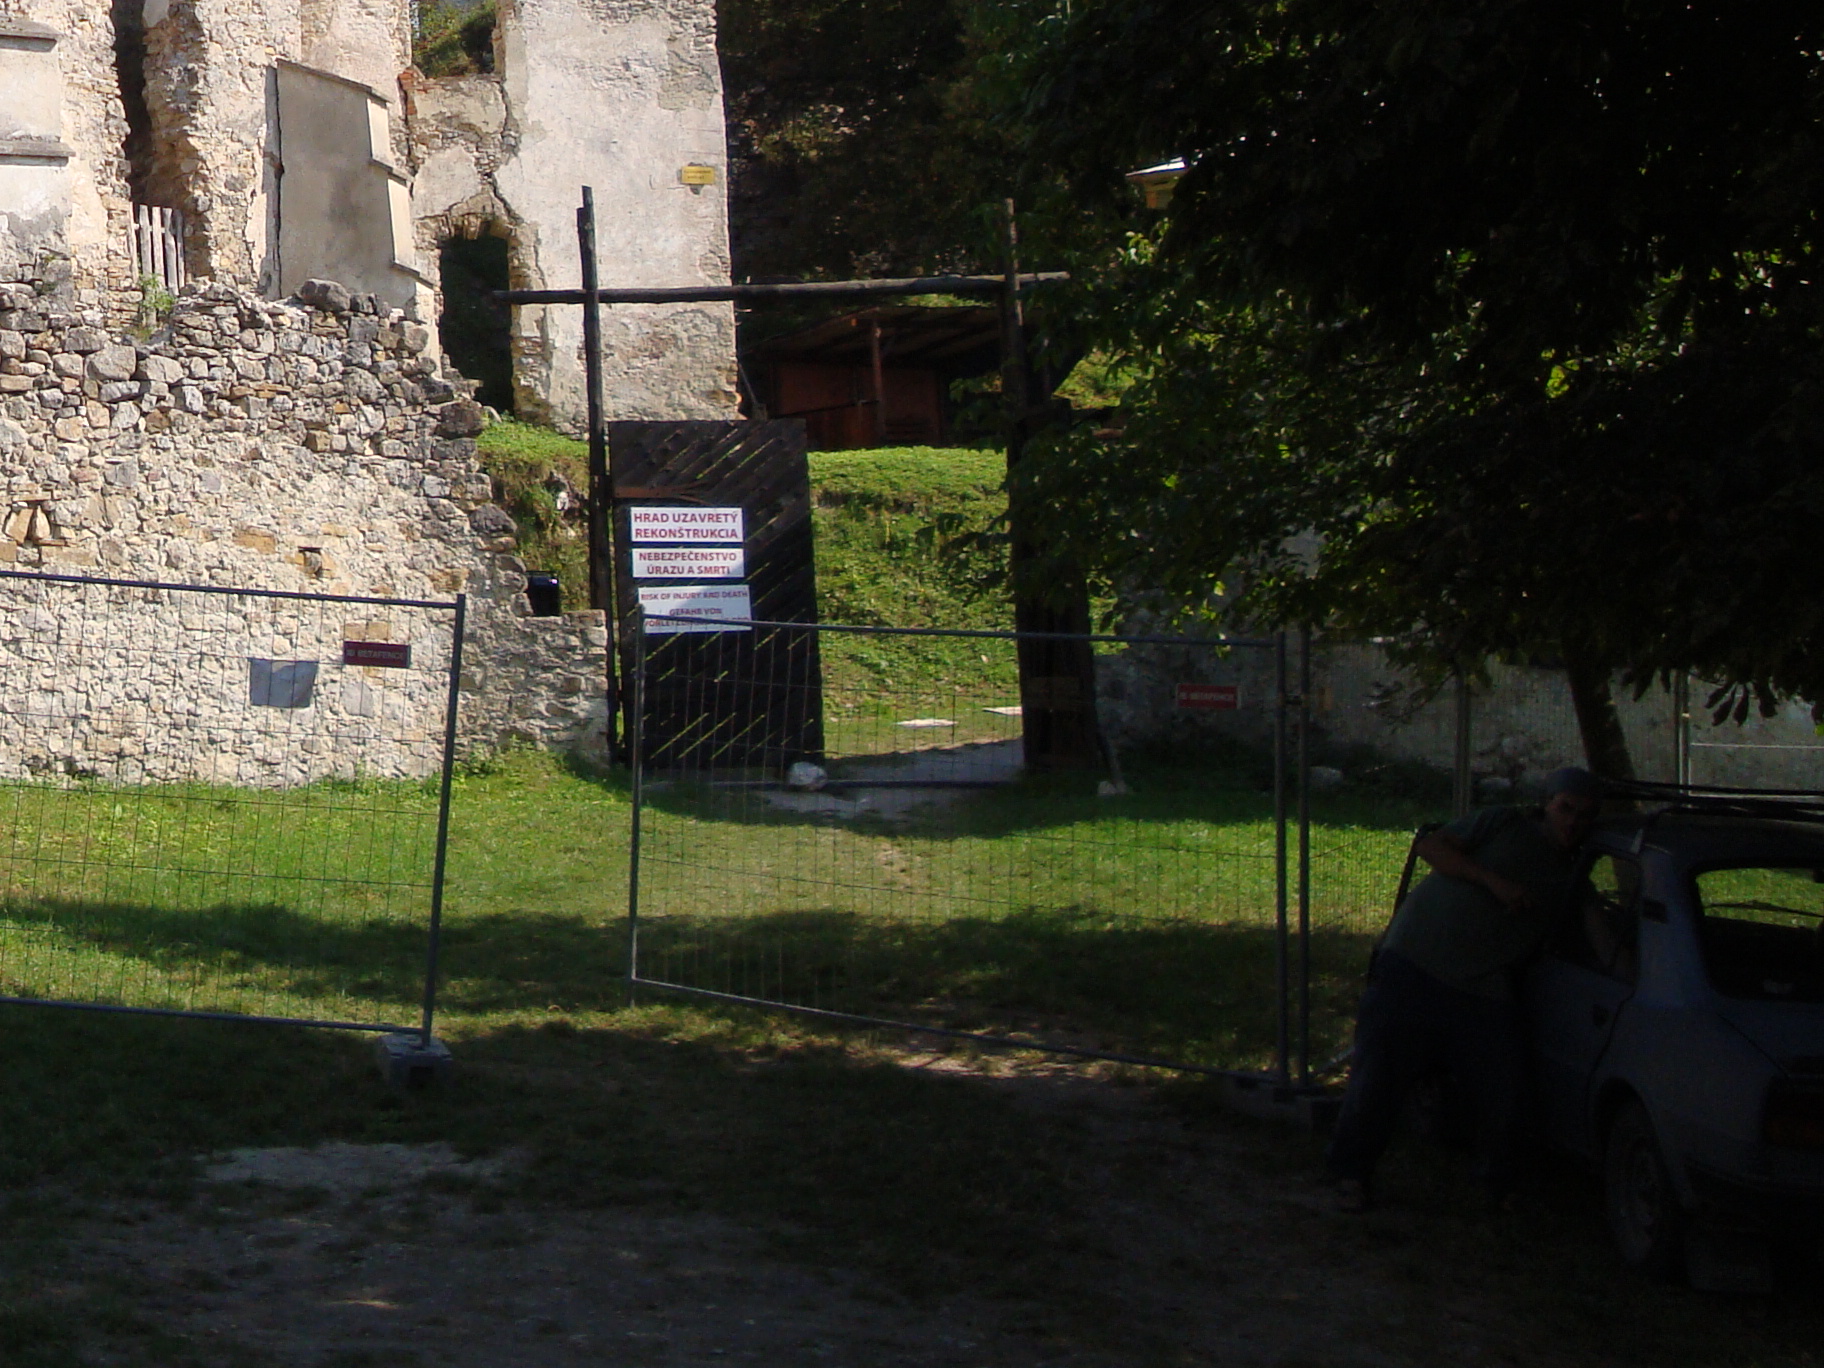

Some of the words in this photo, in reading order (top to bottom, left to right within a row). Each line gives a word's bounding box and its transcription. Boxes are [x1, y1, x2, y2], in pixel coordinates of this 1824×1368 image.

[634, 512, 669, 523] HRAD
[673, 510, 738, 523] UZAVRETÝ
[635, 527, 738, 539] REKONŠTRUKCIA
[639, 551, 737, 561] NEBEZPEČENSTVO
[647, 564, 684, 575] ÚRAZU
[687, 565, 695, 575] A
[697, 565, 730, 575] SMRTI
[641, 593, 659, 601] RISK
[673, 592, 702, 600] INJURY
[703, 591, 721, 599] AND
[721, 590, 748, 599] DEATH
